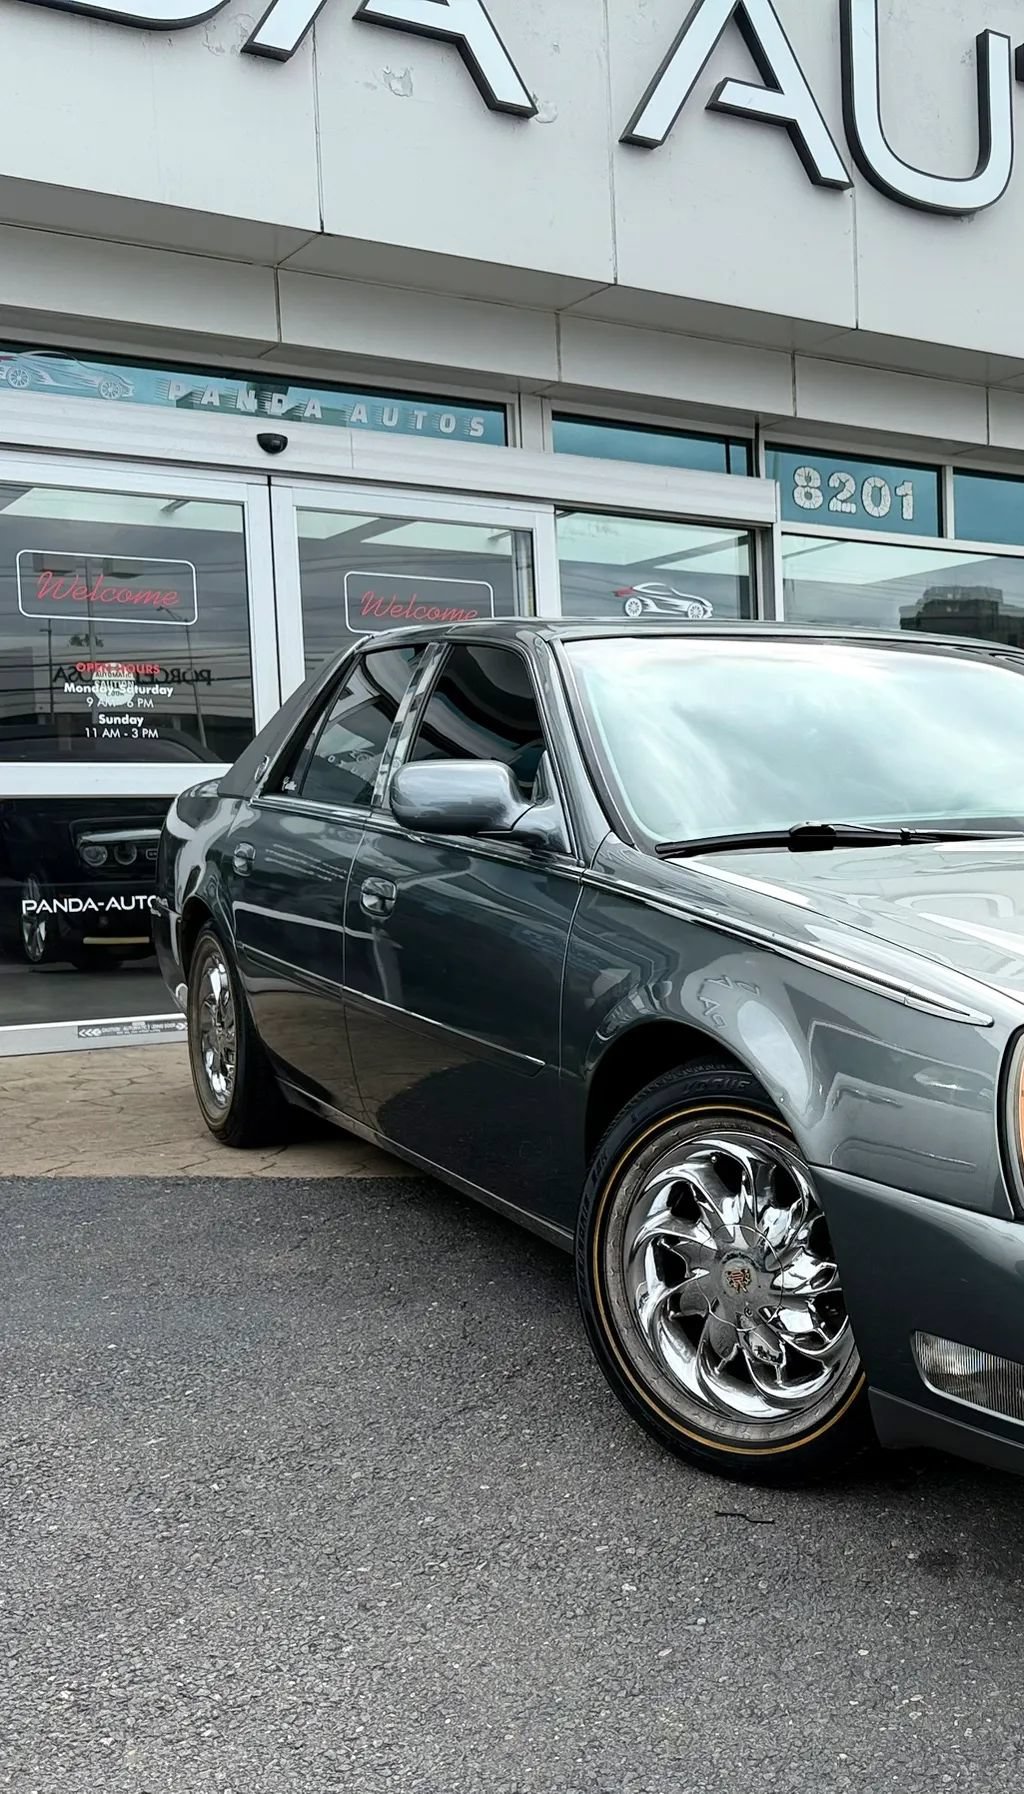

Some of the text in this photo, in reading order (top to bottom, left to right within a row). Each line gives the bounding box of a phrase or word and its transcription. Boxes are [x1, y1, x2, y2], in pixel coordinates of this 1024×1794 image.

[166, 379, 484, 437] PANDA AUTOS
[793, 466, 914, 520] 8201
[36, 571, 181, 606] Welcome
[64, 682, 174, 697] Monday-Saturday
[86, 697, 94, 707] 9
[127, 699, 135, 708] 6
[138, 699, 154, 708] PM
[99, 714, 144, 727] Sunday
[86, 728, 98, 738] 11
[102, 729, 121, 738] AM
[132, 728, 139, 738] 3
[143, 729, 159, 738] PM
